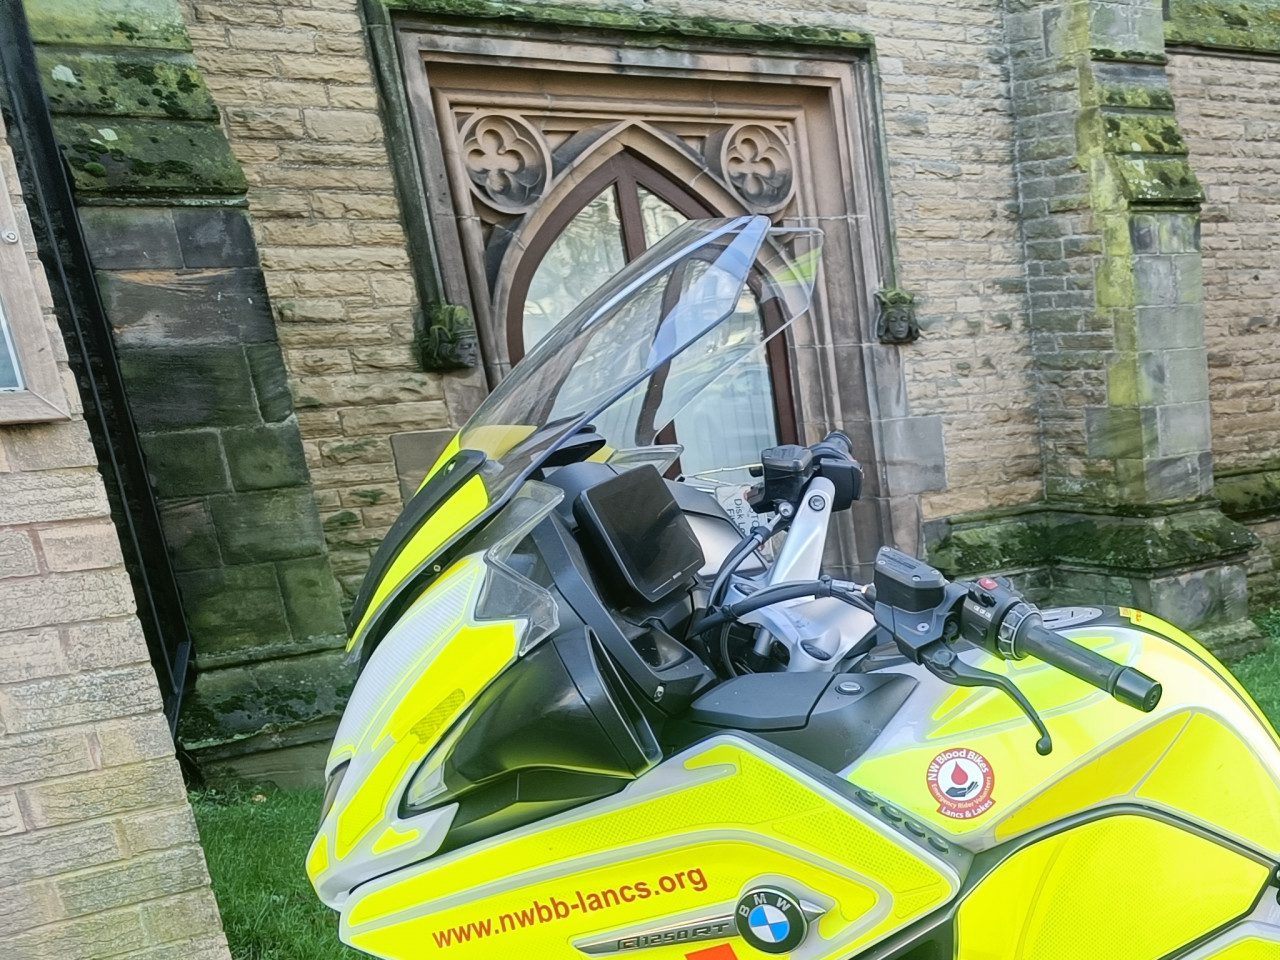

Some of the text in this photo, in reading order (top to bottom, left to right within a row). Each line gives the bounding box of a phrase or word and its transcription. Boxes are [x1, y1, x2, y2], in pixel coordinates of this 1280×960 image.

[927, 749, 989, 781] NW Blood Bikes
[941, 800, 993, 819] Lancs & Lakes
[432, 867, 708, 949] www.nwbb-lancs.org
[738, 893, 791, 918] BMW
